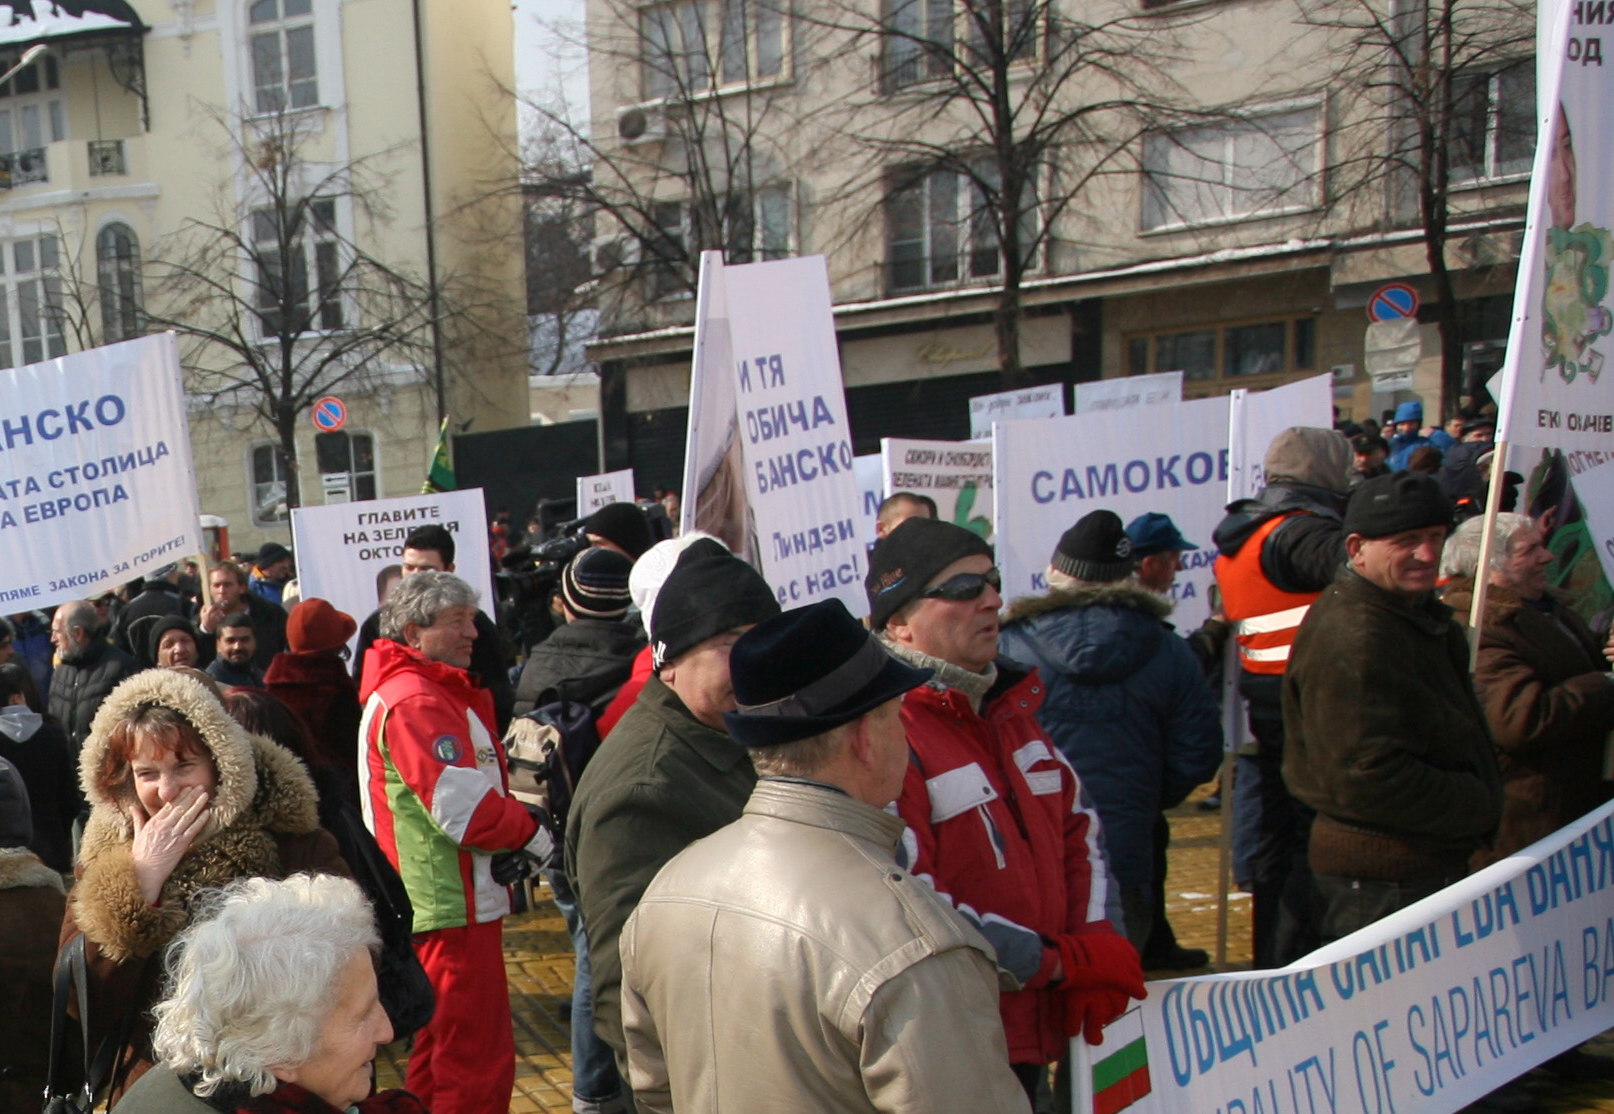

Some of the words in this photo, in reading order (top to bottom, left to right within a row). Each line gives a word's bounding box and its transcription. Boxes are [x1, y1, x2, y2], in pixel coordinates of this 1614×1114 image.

[736, 360, 753, 394] И
[753, 353, 786, 390] ТЯ
[746, 395, 836, 445] ОБИЧА
[47, 440, 170, 489] СТОЛИЦА
[754, 438, 854, 495] БАНСКО
[23, 484, 130, 524] ЕВРОПА
[357, 505, 440, 526] ГЛАВИТЕ
[343, 530, 369, 545] НА
[358, 545, 405, 561] ОКТО
[772, 518, 856, 562] Линдзи
[48, 567, 110, 593] ЗАКОНА
[112, 560, 131, 577] ЗА
[133, 534, 186, 567] ГОРИТЕ!
[1405, 939, 1573, 1098] SAPAREVA
